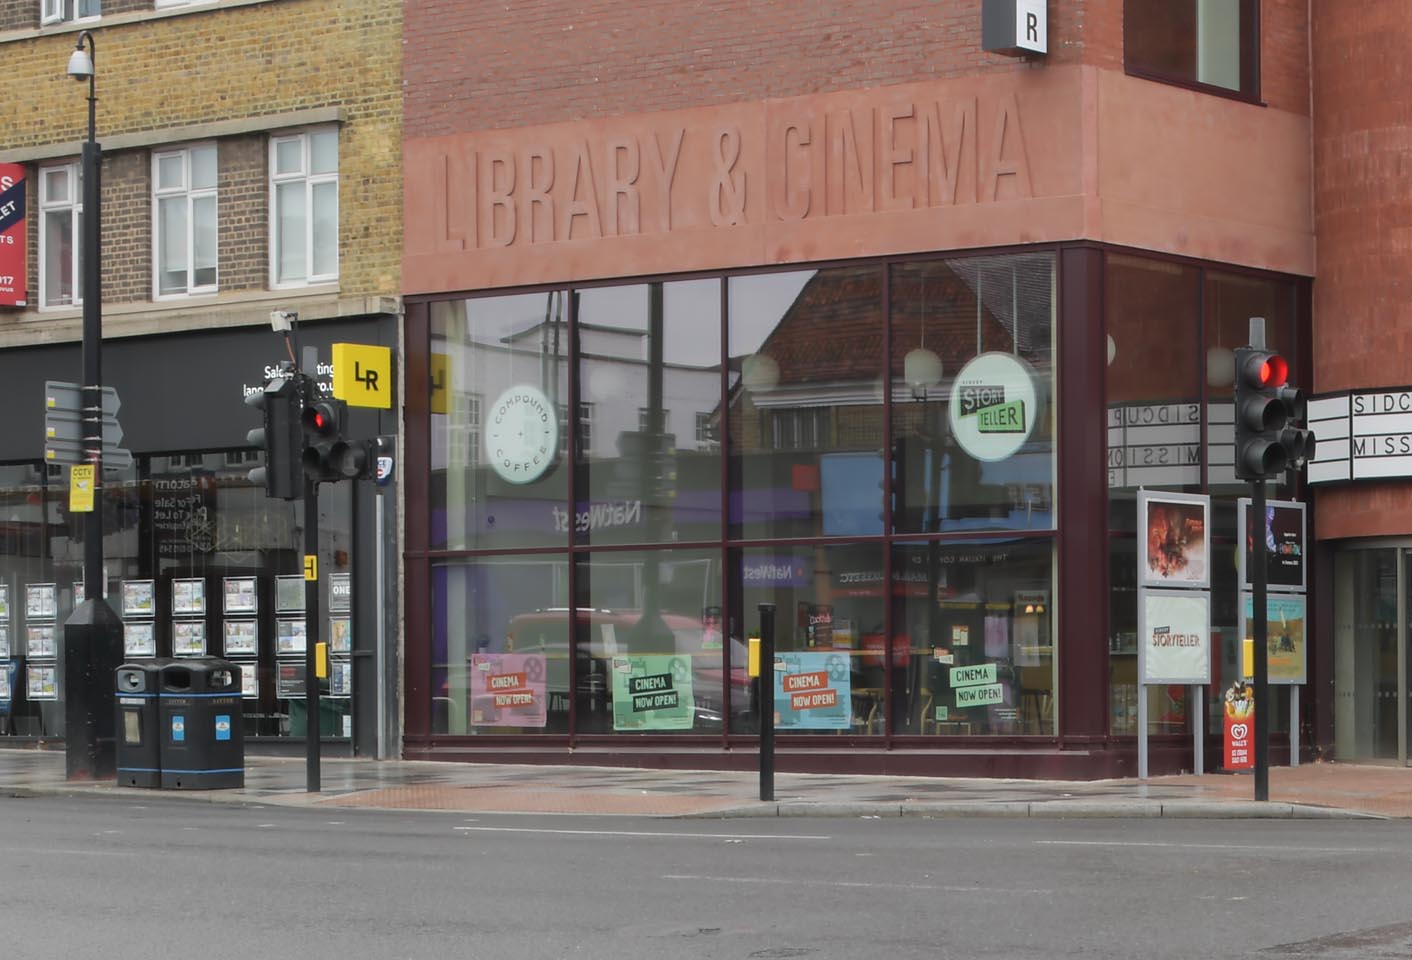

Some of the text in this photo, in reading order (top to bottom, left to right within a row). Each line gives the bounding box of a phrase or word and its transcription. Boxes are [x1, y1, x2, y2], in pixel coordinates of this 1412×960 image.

[439, 94, 1035, 251] LIBRARY & CINEMA
[355, 361, 379, 391] LR
[964, 388, 1005, 410] STORY
[495, 395, 548, 425] COMPOUND
[980, 406, 1019, 426] TELLER
[496, 446, 548, 472] COFFEE
[72, 468, 92, 476] CCTV
[1152, 634, 1200, 647] STORYTELLER
[491, 675, 519, 689] CINEMA
[788, 674, 820, 689] CINEMA
[956, 668, 989, 682] CINEMA
[635, 676, 667, 691] CINEMA
[495, 693, 532, 705] NOW OPEN!
[635, 694, 677, 708] NOW OPEN!
[793, 692, 835, 707] NOW OPEN!
[958, 688, 1001, 701] NOW OPEN!
